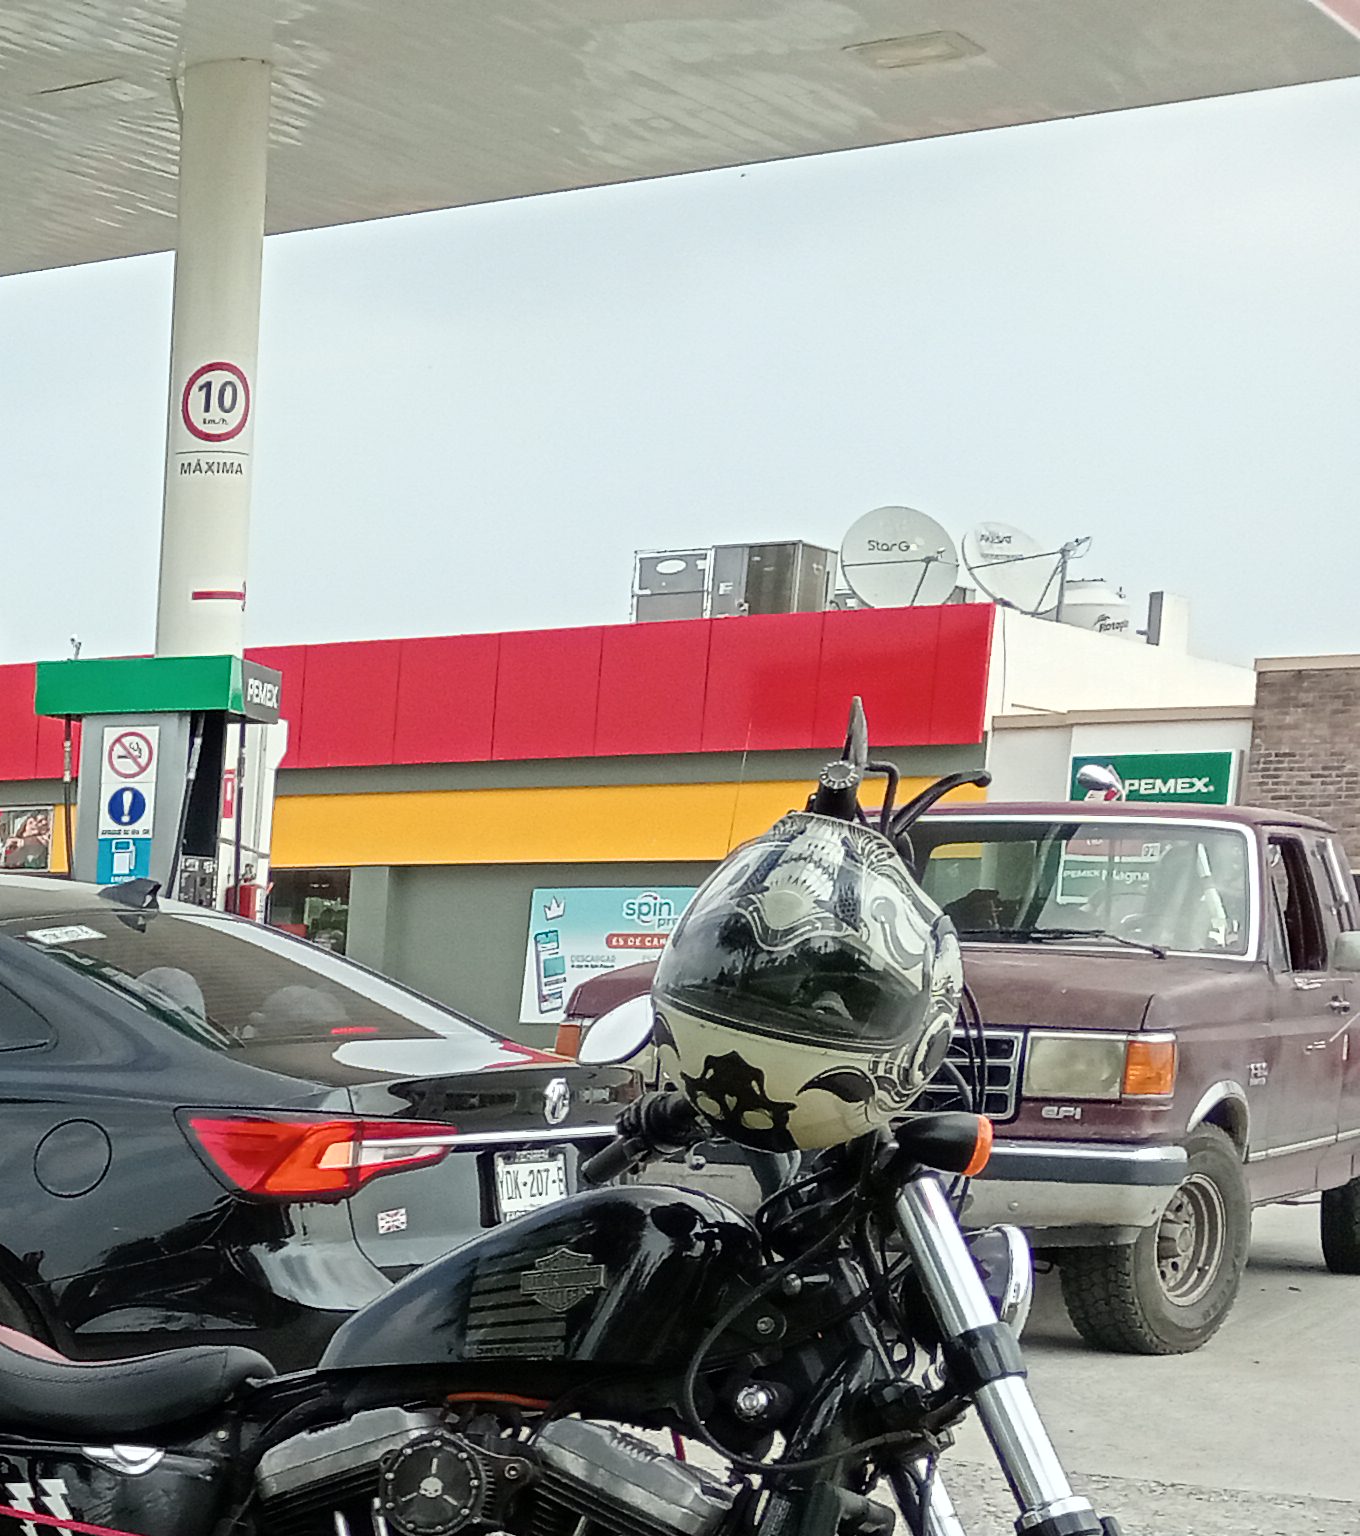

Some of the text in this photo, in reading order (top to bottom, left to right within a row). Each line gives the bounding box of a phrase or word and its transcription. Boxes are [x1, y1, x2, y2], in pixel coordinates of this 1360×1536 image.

[198, 380, 238, 414] 10
[179, 458, 244, 476] MÁXIMA
[246, 678, 279, 708] PEMEX
[1124, 777, 1210, 795] PEMEX
[624, 898, 673, 921] spin
